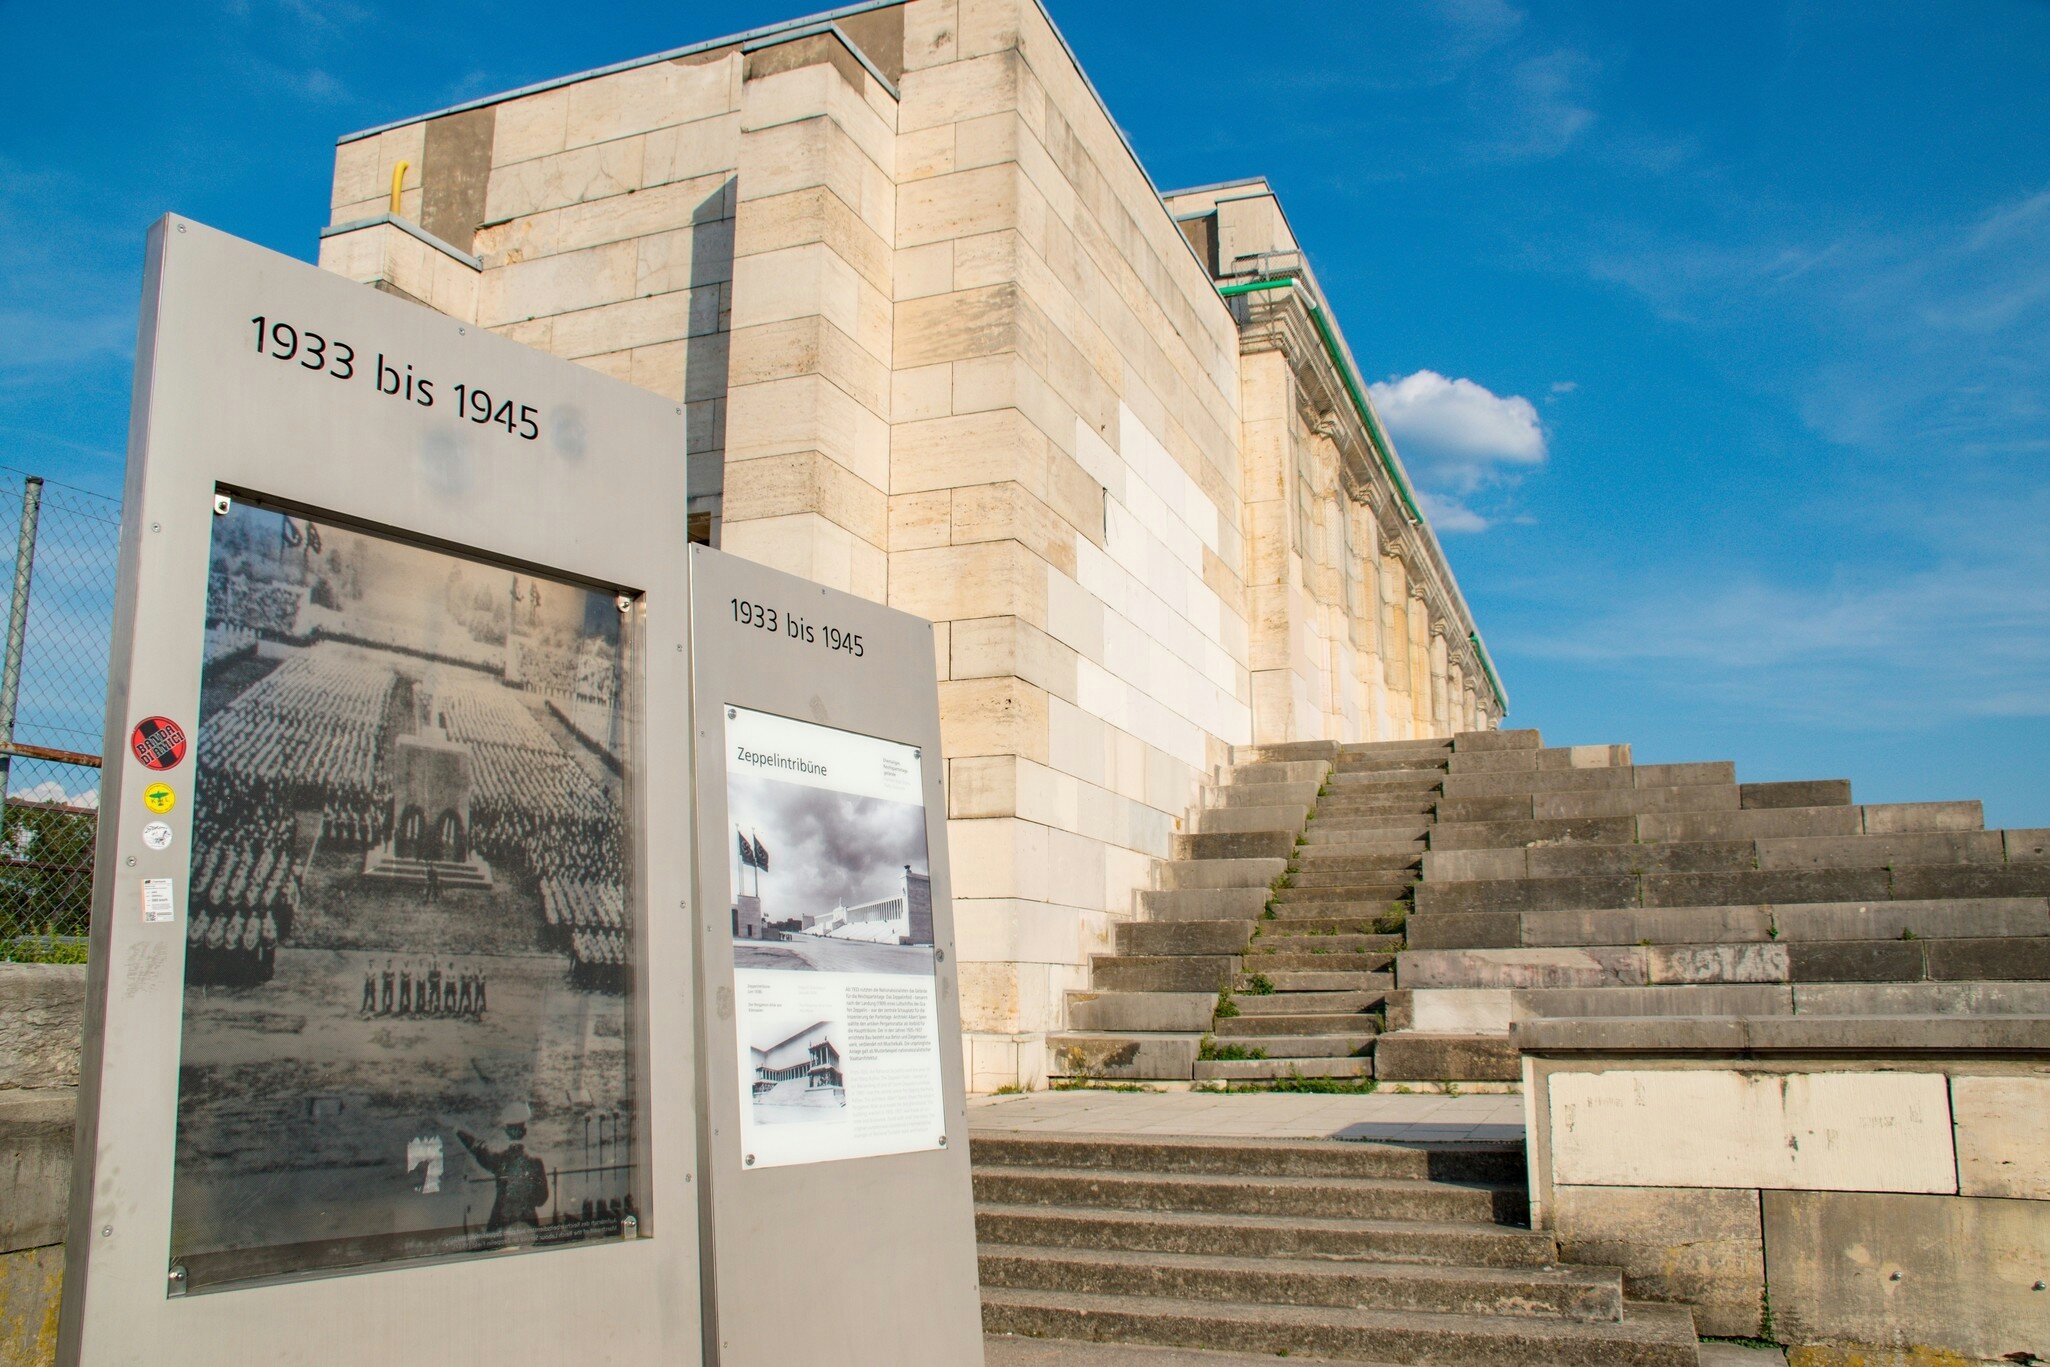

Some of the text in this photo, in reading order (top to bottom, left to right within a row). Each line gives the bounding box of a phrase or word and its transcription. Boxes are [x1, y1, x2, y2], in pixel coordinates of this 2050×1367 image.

[251, 315, 539, 440] 1933 bis 1945
[731, 598, 864, 657] 1933 bis 1945
[136, 725, 175, 754] BANDA
[141, 732, 183, 764] DI AMICI
[737, 746, 827, 776] Zeppelintribüne
